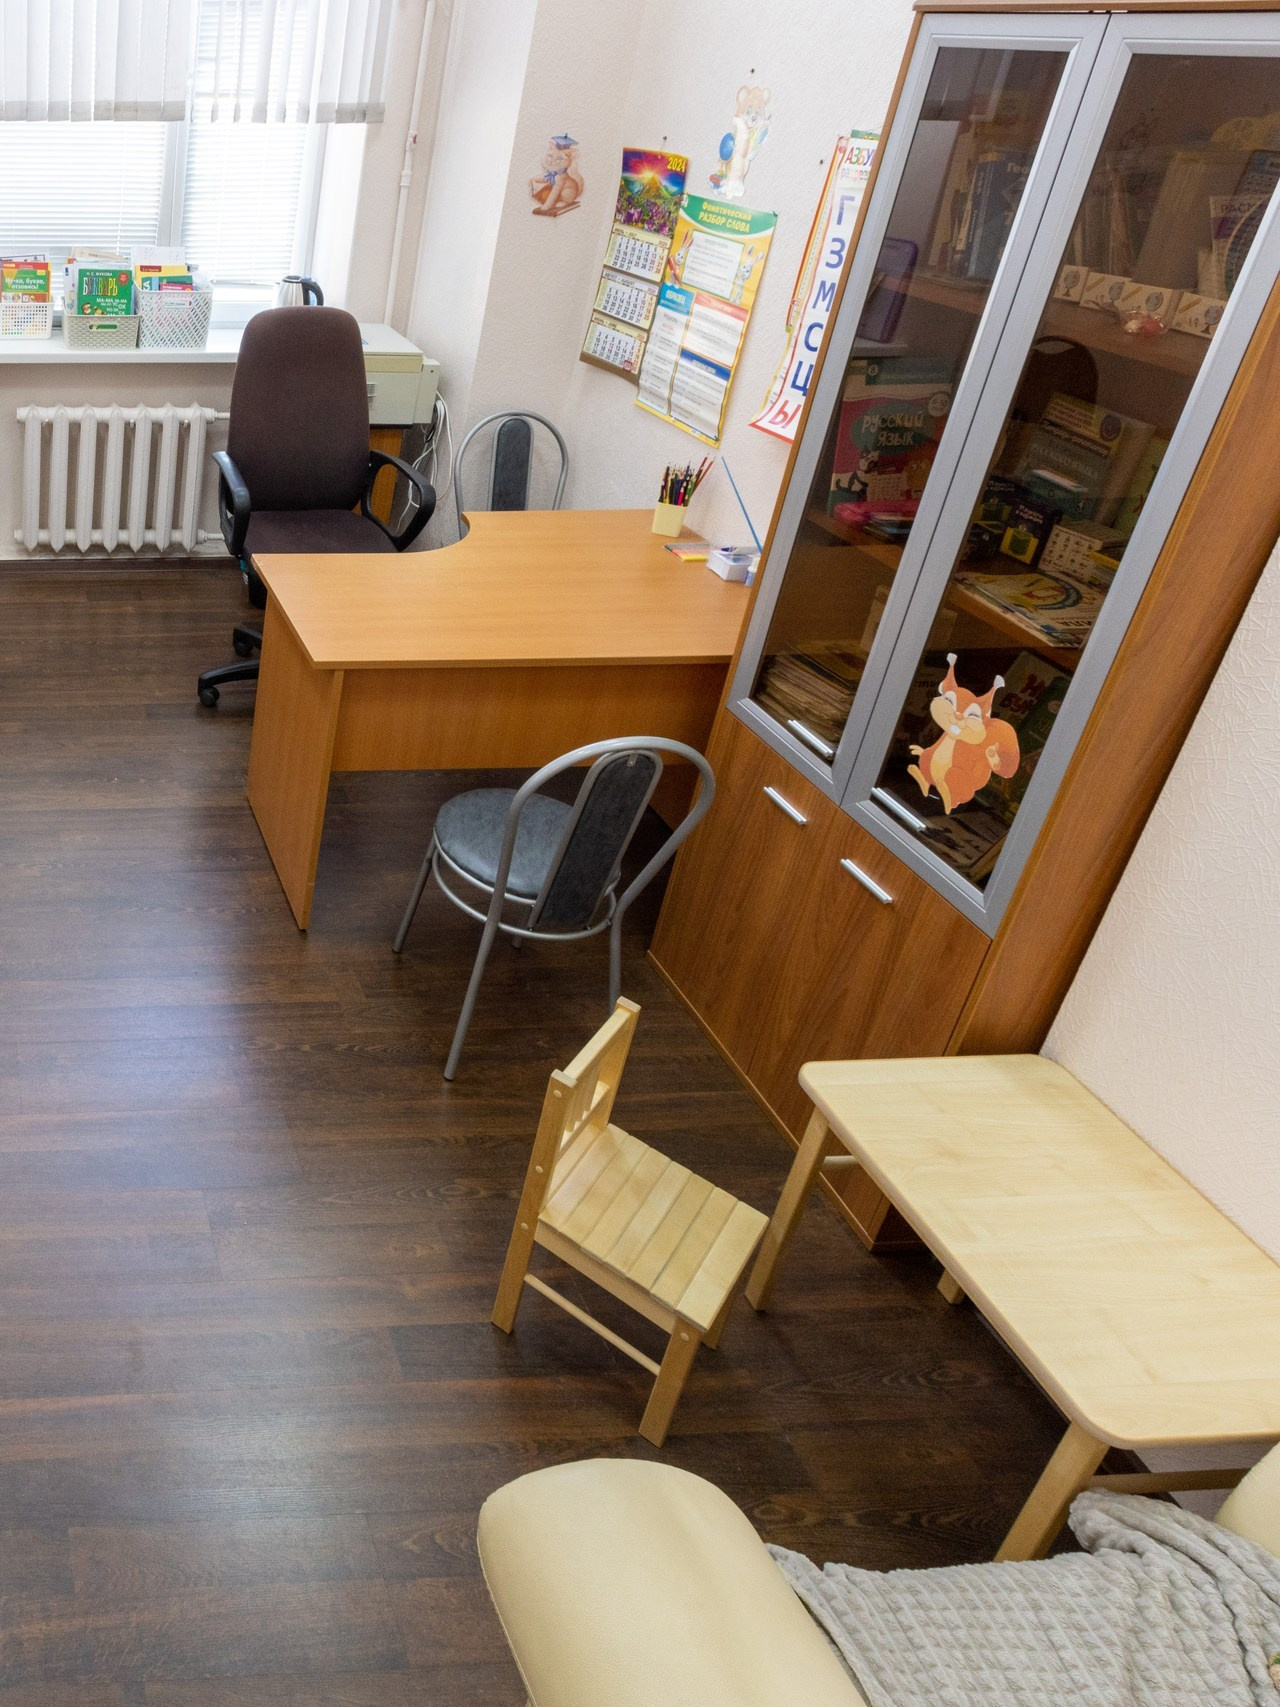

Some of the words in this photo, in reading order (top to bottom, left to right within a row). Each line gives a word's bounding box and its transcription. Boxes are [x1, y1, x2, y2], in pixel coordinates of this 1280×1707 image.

[667, 156, 687, 173] 2024
[845, 146, 877, 167] АЗБУ
[698, 211, 726, 225] РАЗБОР
[726, 218, 751, 233] СЛОВА
[702, 201, 753, 221] Фонетический
[836, 195, 855, 226] Г
[825, 237, 846, 269] З
[82, 277, 118, 296] БУКВАРЬ
[812, 280, 836, 312] М
[804, 322, 824, 352] С
[768, 398, 802, 430] Ы
